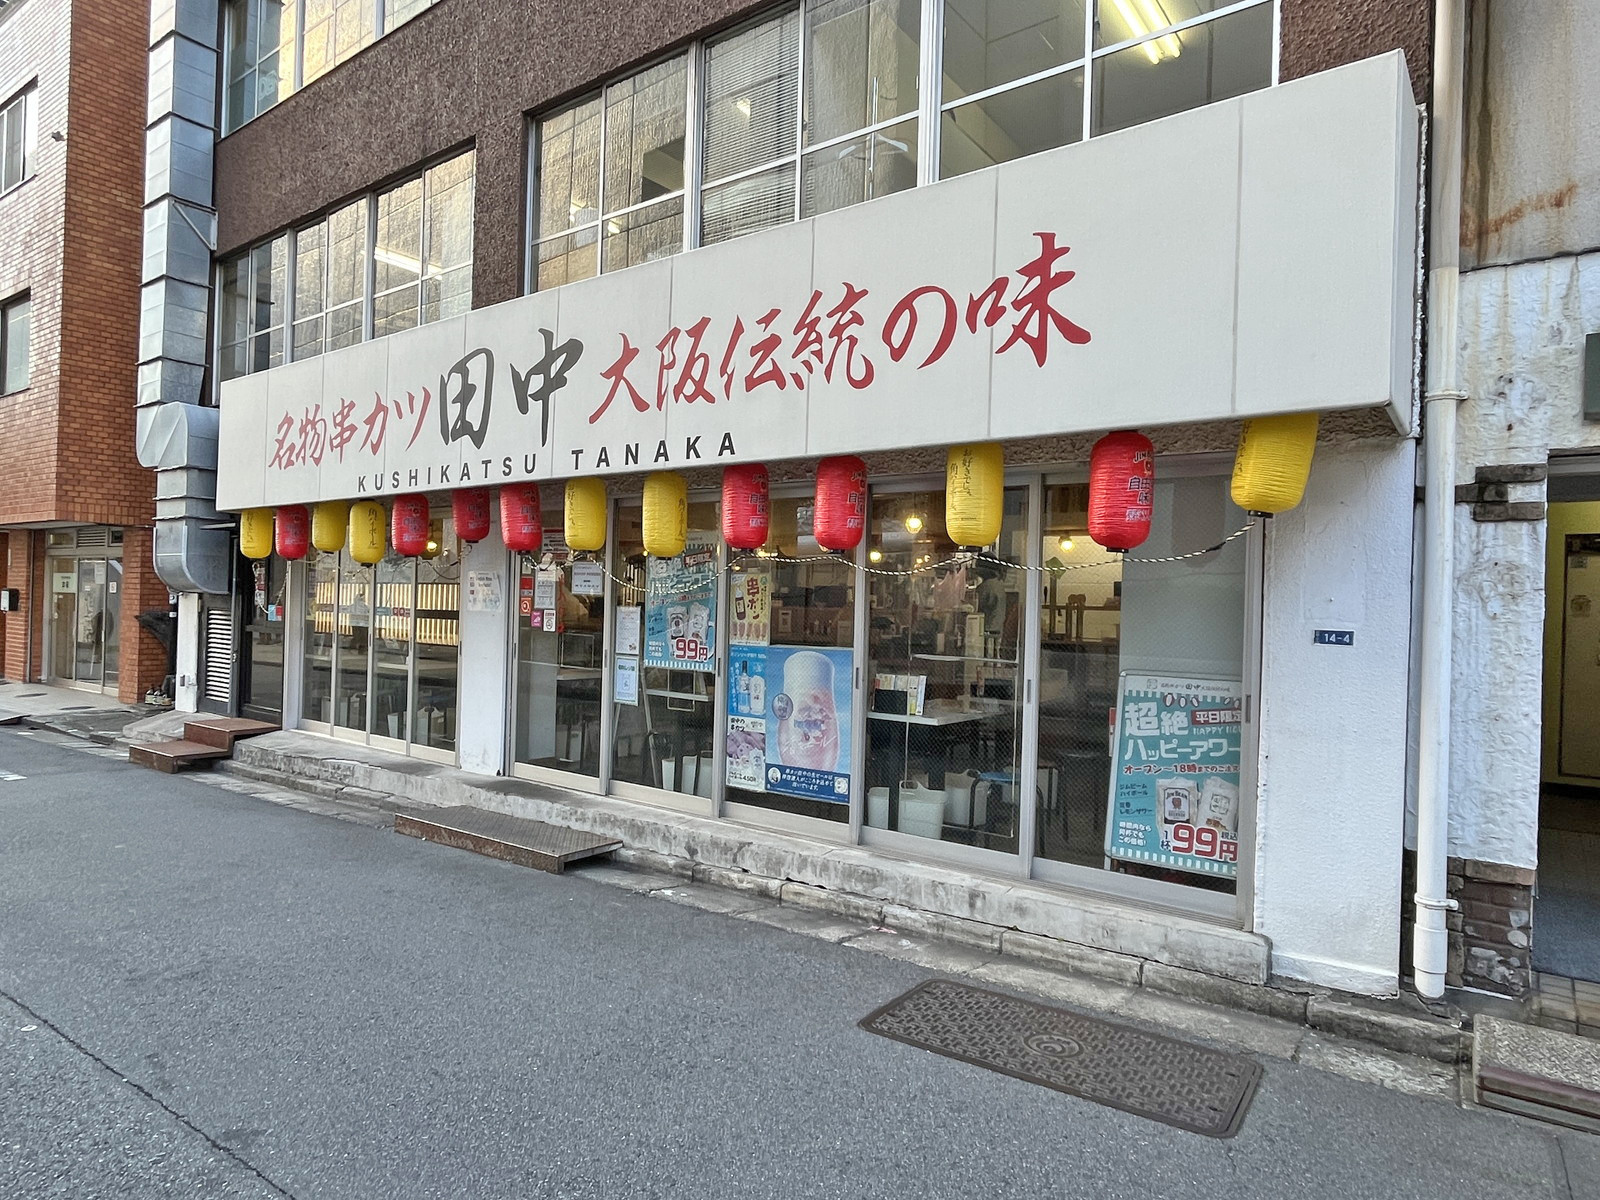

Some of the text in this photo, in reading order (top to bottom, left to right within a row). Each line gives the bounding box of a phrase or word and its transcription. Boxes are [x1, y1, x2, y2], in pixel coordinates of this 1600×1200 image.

[268, 232, 1092, 469] 名物串カツ 田中 大阪伝統の味
[358, 432, 736, 492] KUSHIKATSU TANAKA
[1324, 633, 1350, 643] 14-4
[1125, 702, 1190, 737] 超絶
[1193, 726, 1224, 735] HAPPY
[1124, 738, 1240, 761] ハッピーアワー
[1173, 823, 1238, 862] 99円
